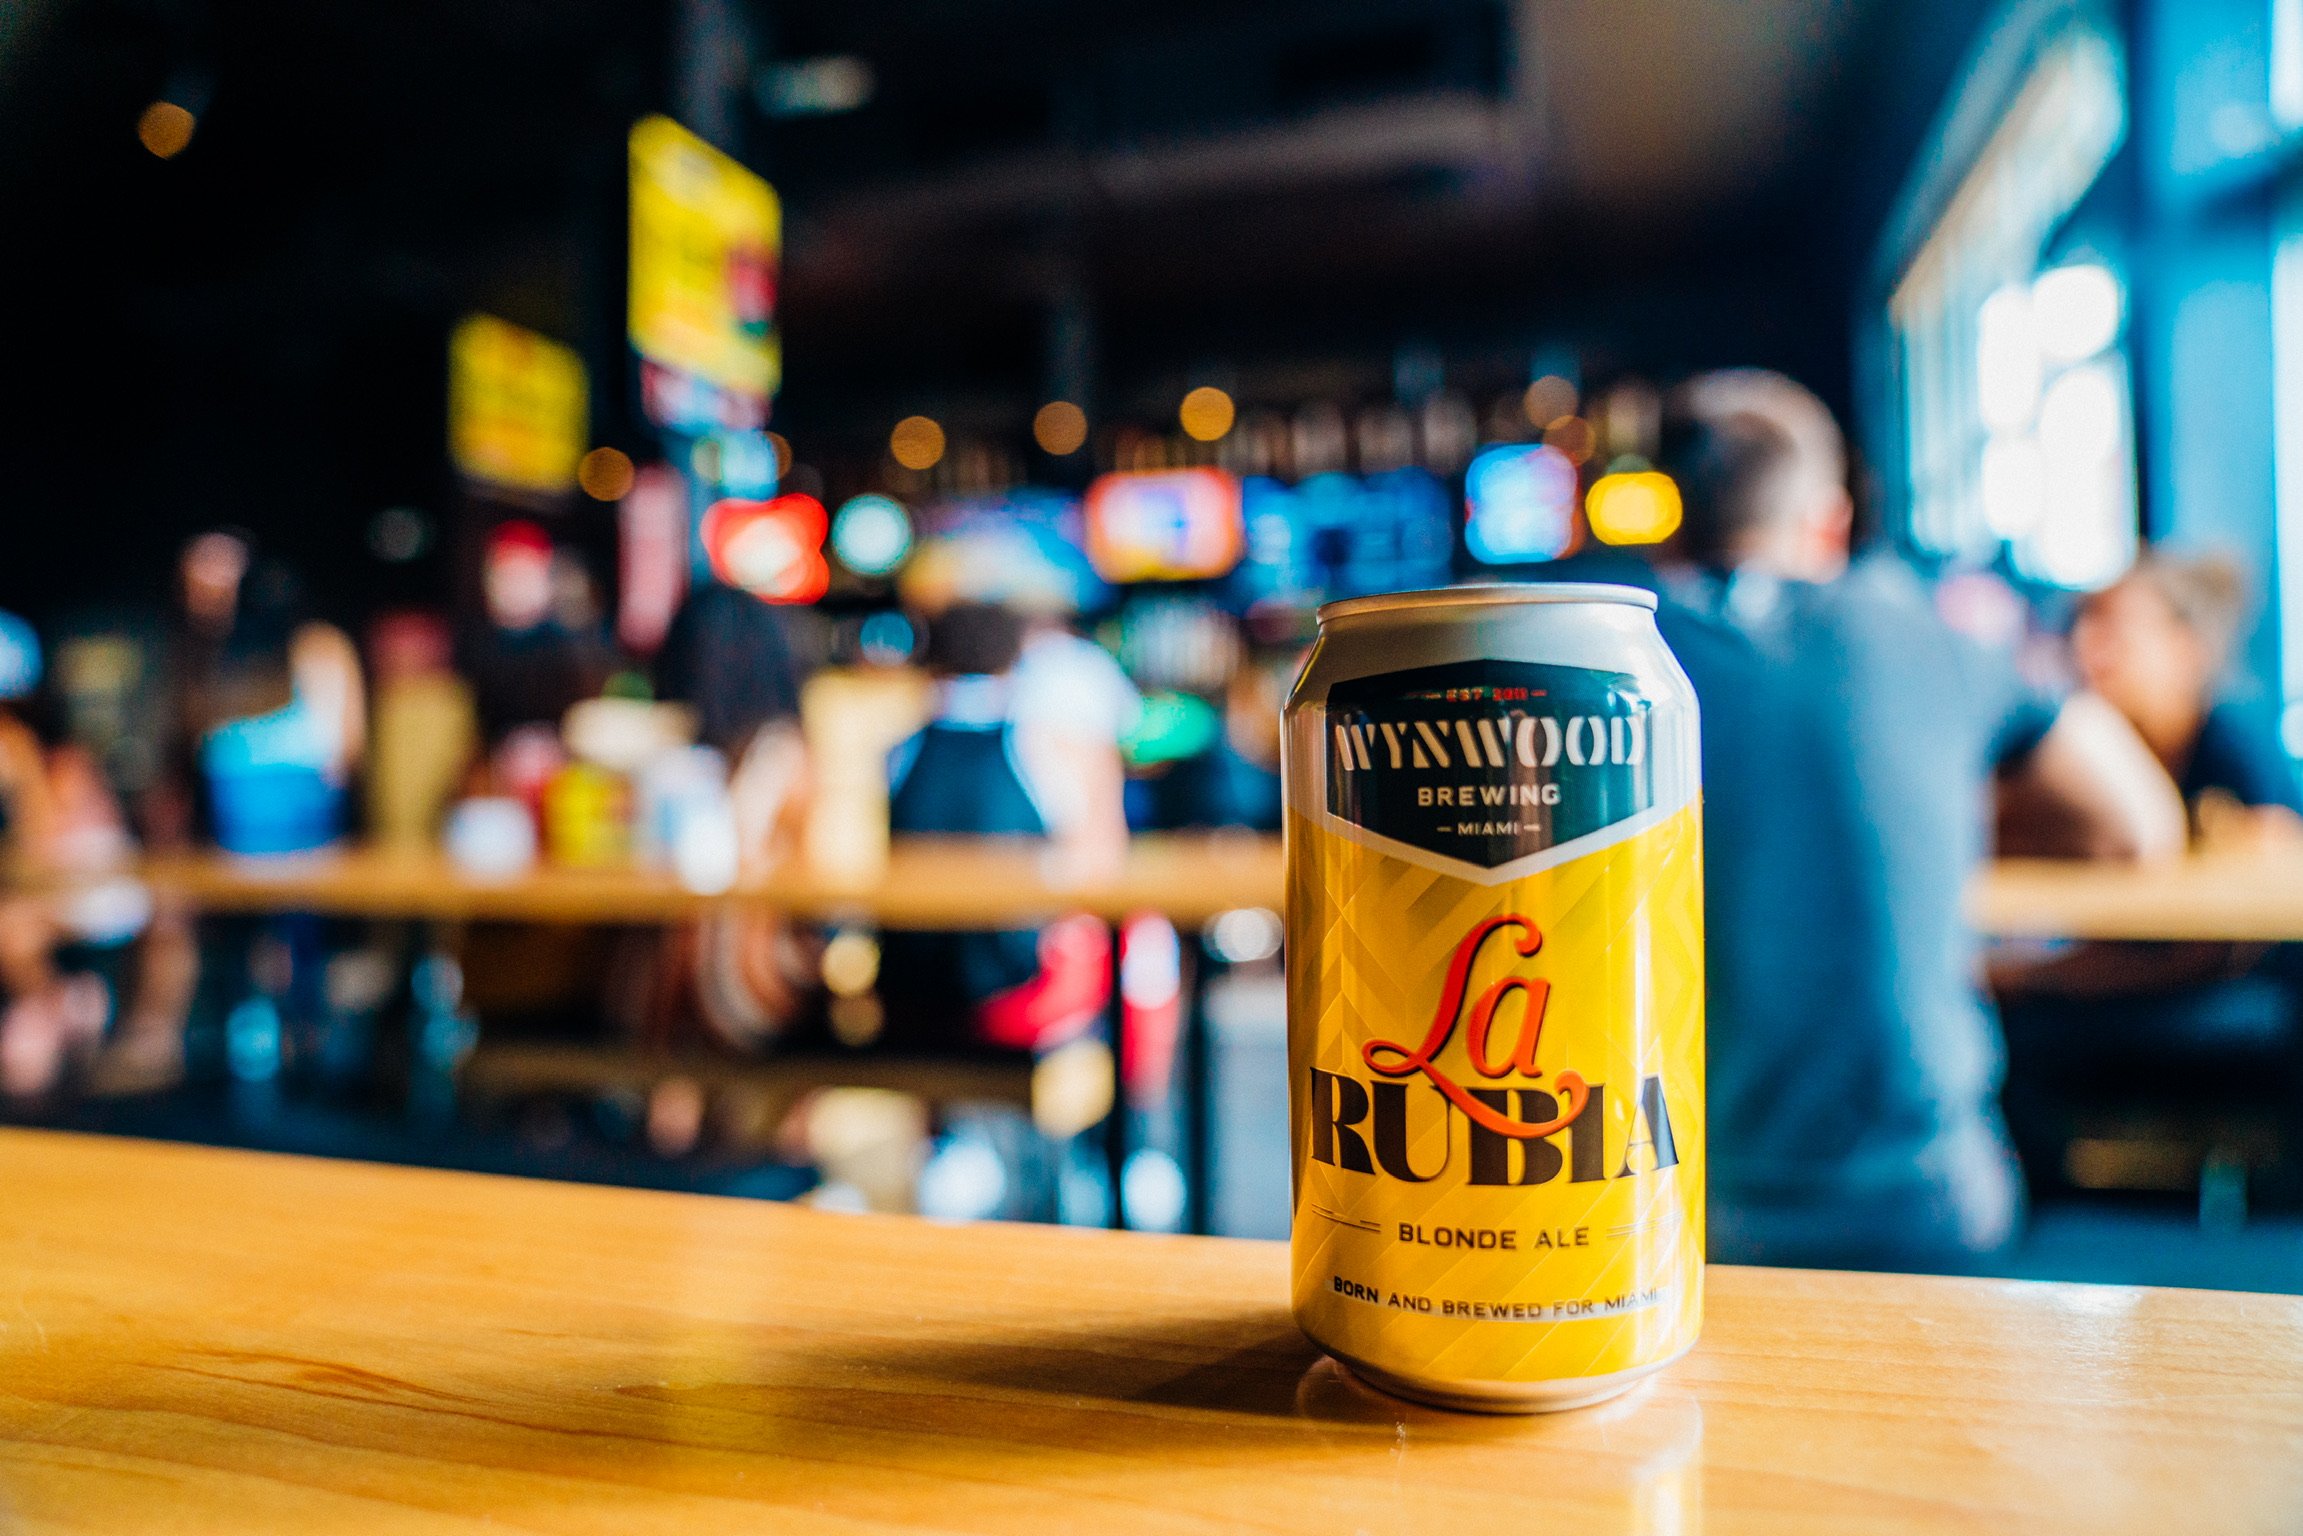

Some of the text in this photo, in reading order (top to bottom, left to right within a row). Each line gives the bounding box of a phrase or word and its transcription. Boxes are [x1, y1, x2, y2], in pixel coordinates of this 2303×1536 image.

[1335, 715, 1647, 772] WYNWOOD
[1417, 783, 1562, 808] BREWING
[1458, 821, 1519, 837] MIAMI
[1361, 913, 1591, 1139] La
[1309, 1066, 1680, 1187] RUBIA
[1399, 1222, 1590, 1250] BLONDE ALE
[1333, 1275, 1379, 1304] BORN
[1387, 1292, 1432, 1313] AND
[1442, 1299, 1542, 1319] BREWED
[1553, 1299, 1595, 1317] FOR
